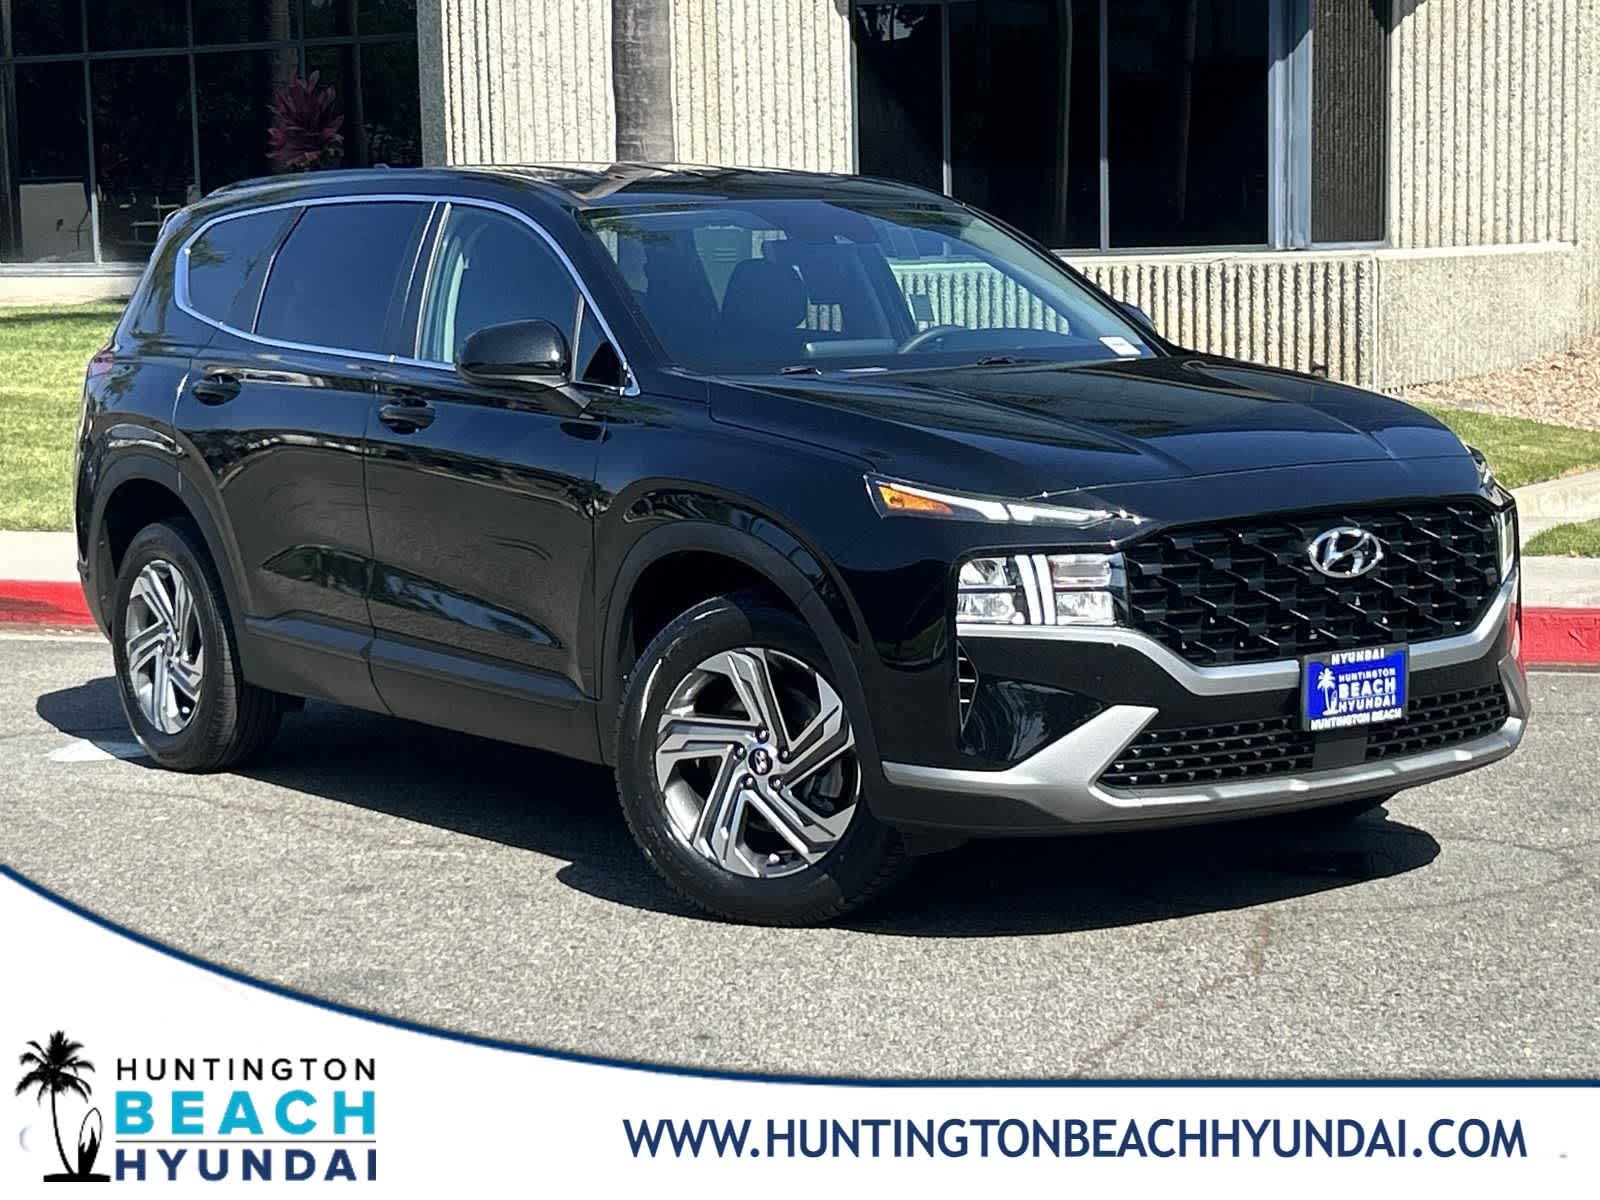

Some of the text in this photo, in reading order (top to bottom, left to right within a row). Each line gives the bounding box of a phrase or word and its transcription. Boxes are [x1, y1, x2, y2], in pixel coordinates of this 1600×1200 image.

[1331, 648, 1385, 665] HYUNDAI
[1338, 668, 1396, 682] HUNTINGTON
[1338, 677, 1396, 699] BEACH
[1338, 695, 1396, 712] HYUNDAI
[1311, 708, 1402, 731] HUNTINGTON BEACH
